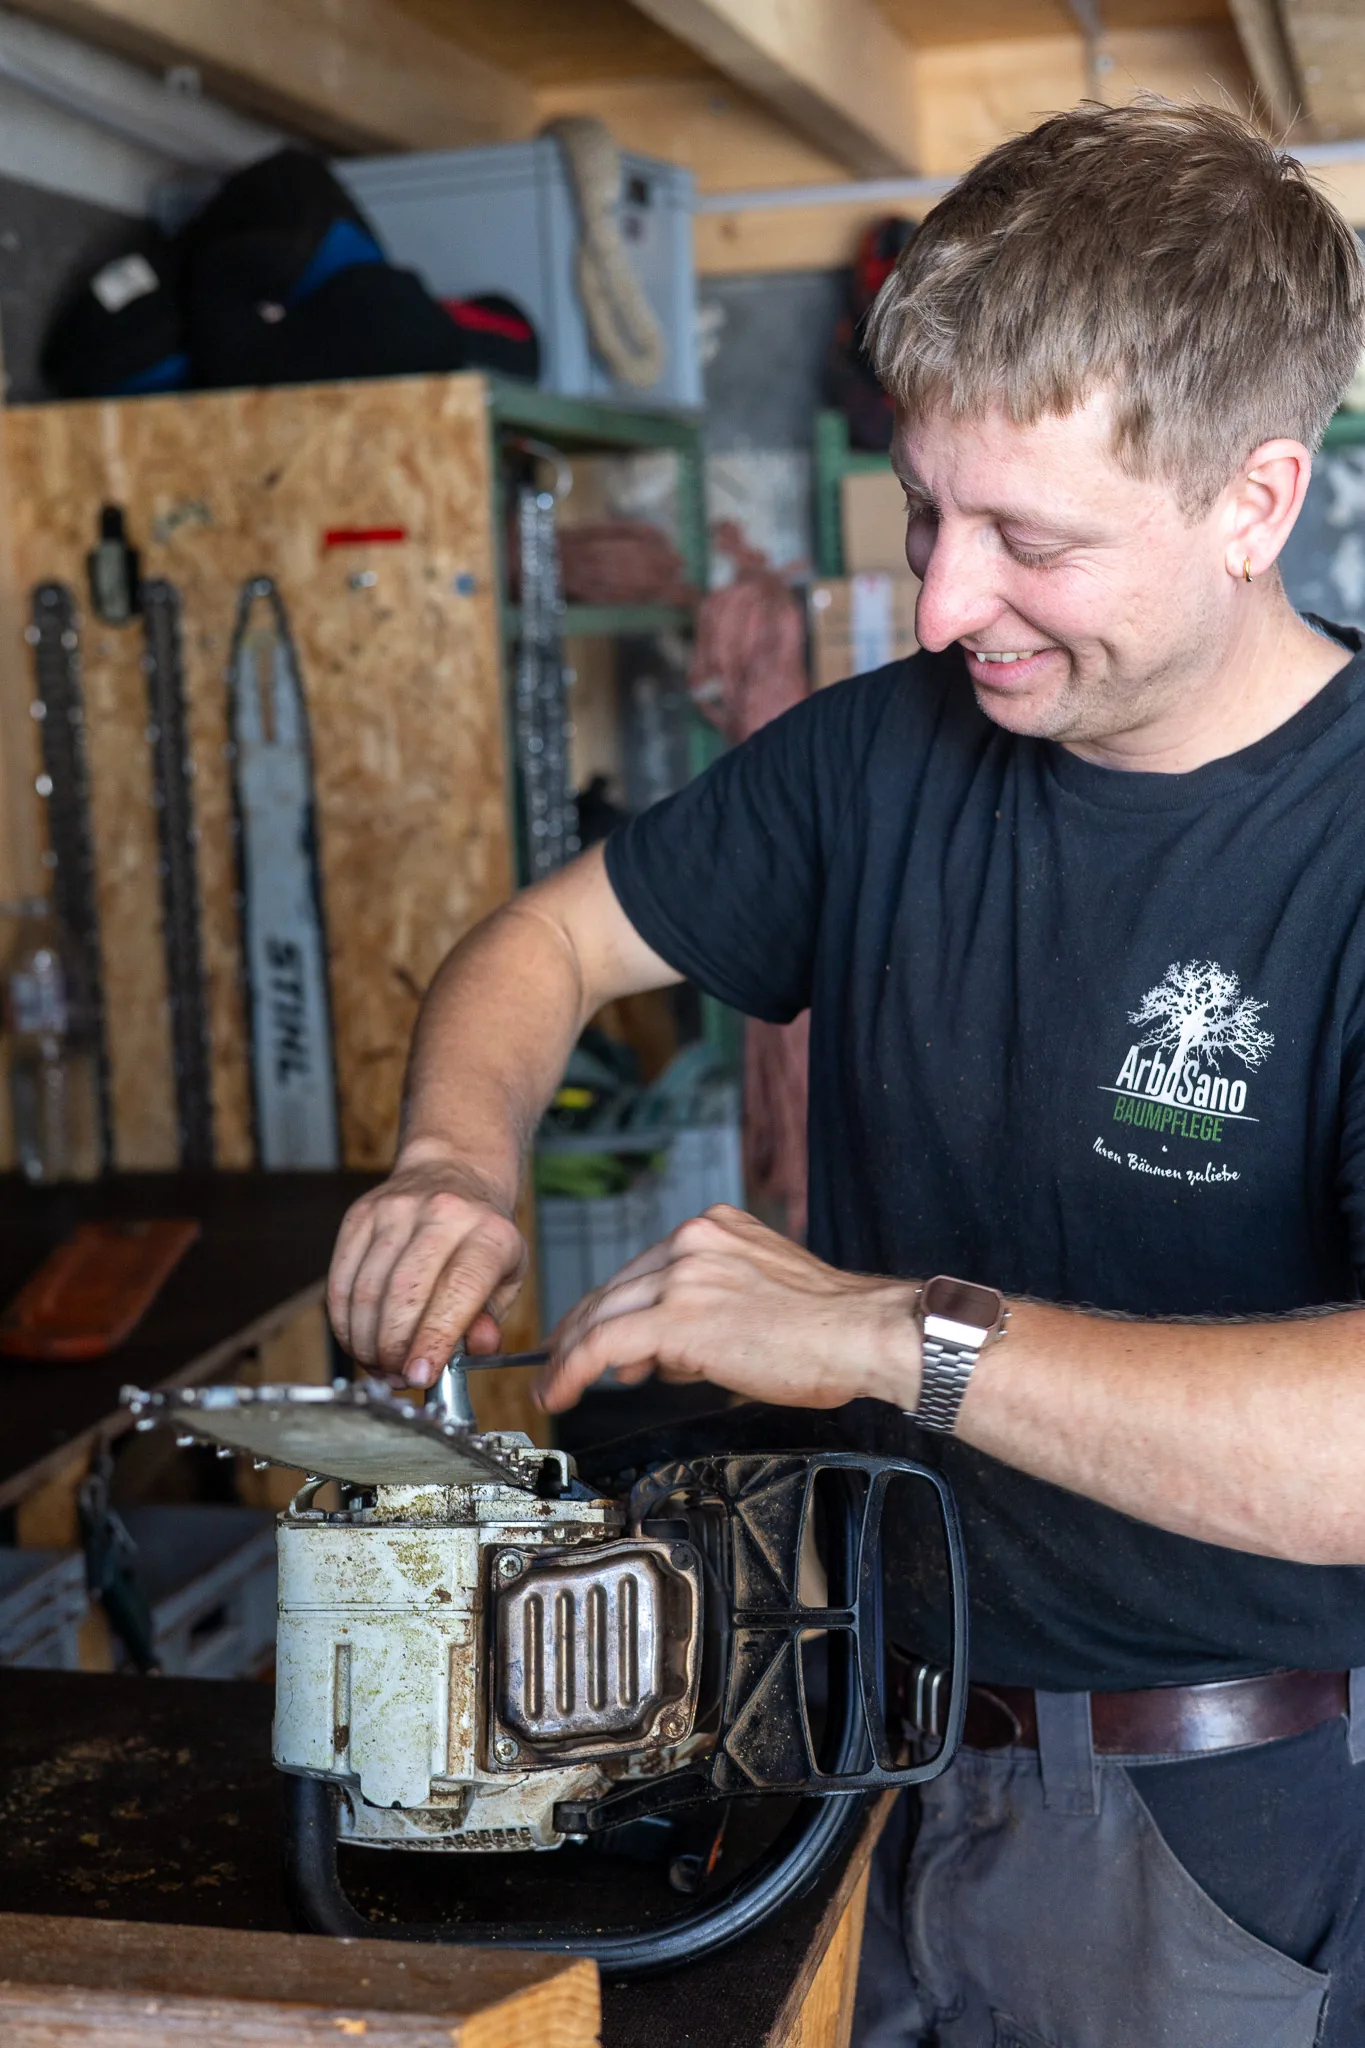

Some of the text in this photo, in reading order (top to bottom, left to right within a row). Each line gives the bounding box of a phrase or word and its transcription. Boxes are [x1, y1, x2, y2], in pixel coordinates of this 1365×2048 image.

[265, 936, 312, 1087] STIHL
[1115, 1045, 1248, 1113] ArboSano
[1112, 1096, 1225, 1142] BAUMPFLEGE
[1092, 1136, 1241, 1186] Ihren Bäumen zuliebe
